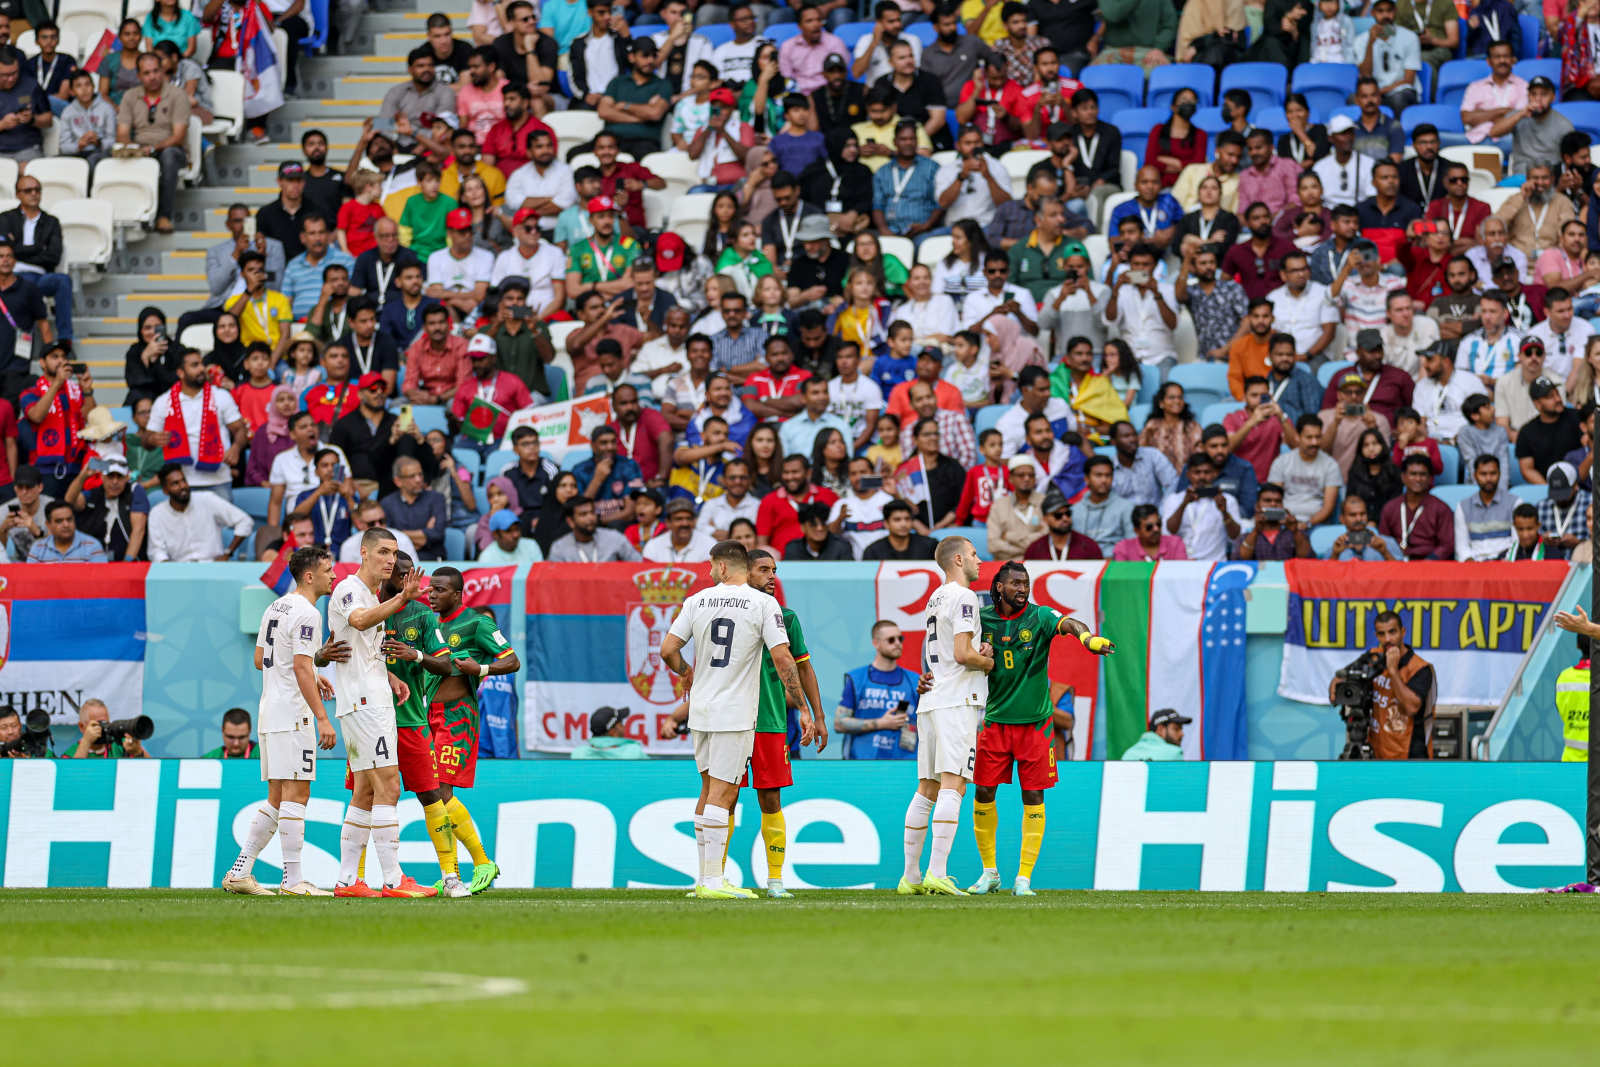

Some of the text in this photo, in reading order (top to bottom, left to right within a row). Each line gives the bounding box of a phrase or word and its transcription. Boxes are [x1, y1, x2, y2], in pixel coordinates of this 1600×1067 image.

[264, 619, 278, 668] 5
[710, 617, 735, 668] 9
[1004, 650, 1014, 669] 8
[0, 689, 83, 716] HEN
[375, 736, 389, 759] 4
[440, 745, 461, 766] 25
[302, 750, 313, 772] 5
[3, 760, 880, 889] Hisense
